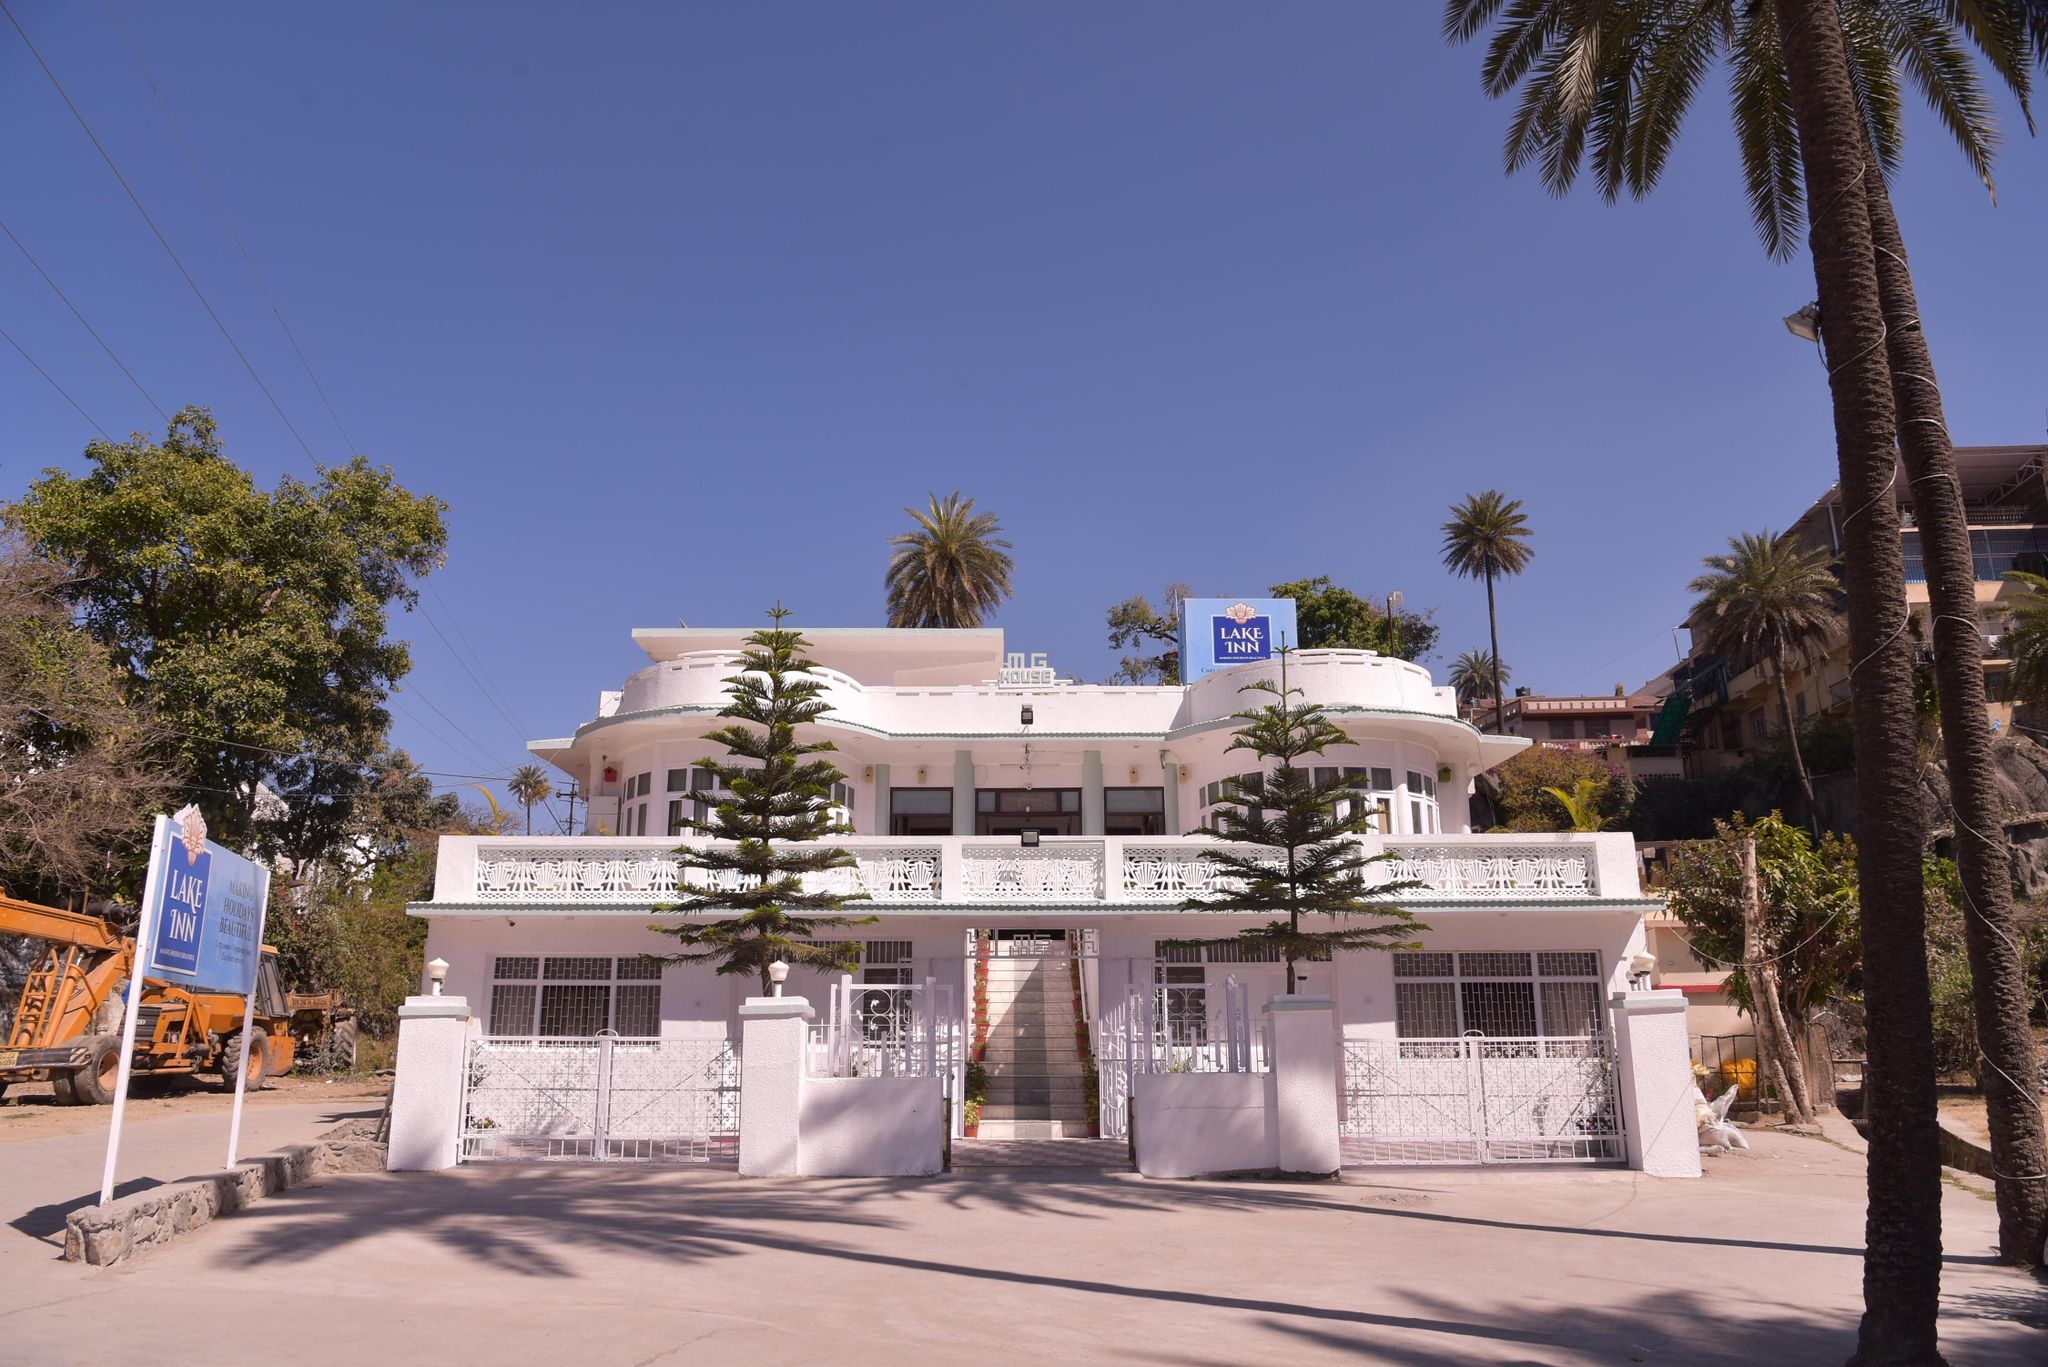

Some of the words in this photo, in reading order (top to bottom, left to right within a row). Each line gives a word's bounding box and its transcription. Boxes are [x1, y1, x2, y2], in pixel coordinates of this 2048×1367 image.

[1221, 627, 1264, 641] LAKE
[1225, 641, 1260, 653] INN
[1000, 670, 1051, 684] HOUSE
[170, 869, 203, 914] LAKE
[229, 880, 254, 901] MAKING
[223, 897, 254, 922] HOLIDAYS
[169, 908, 197, 944] INN
[219, 917, 253, 942] BEAUTIFUL
